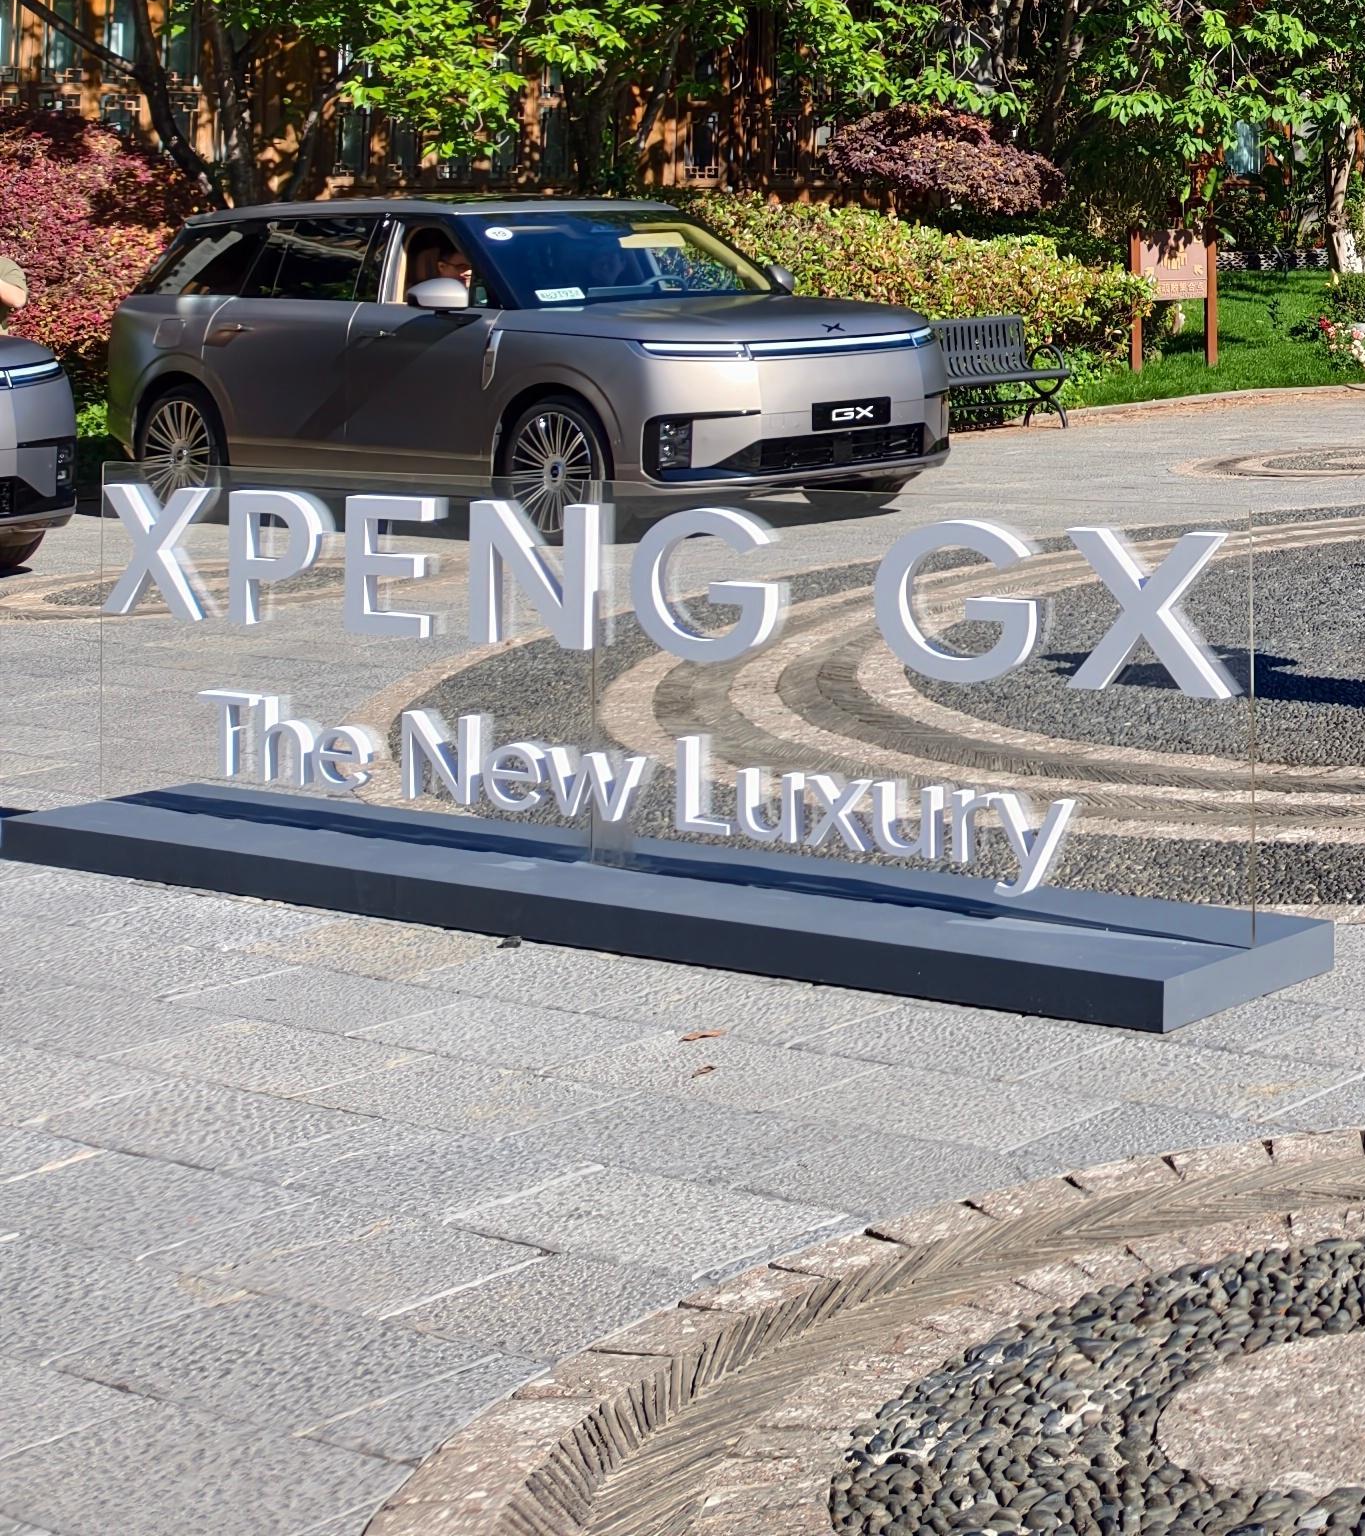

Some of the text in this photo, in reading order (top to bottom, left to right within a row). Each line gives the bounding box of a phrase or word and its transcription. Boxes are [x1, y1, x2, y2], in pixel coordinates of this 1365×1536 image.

[831, 405, 874, 422] GX
[101, 483, 1242, 700] XPENG GX
[198, 689, 1077, 898] The New Luxury
